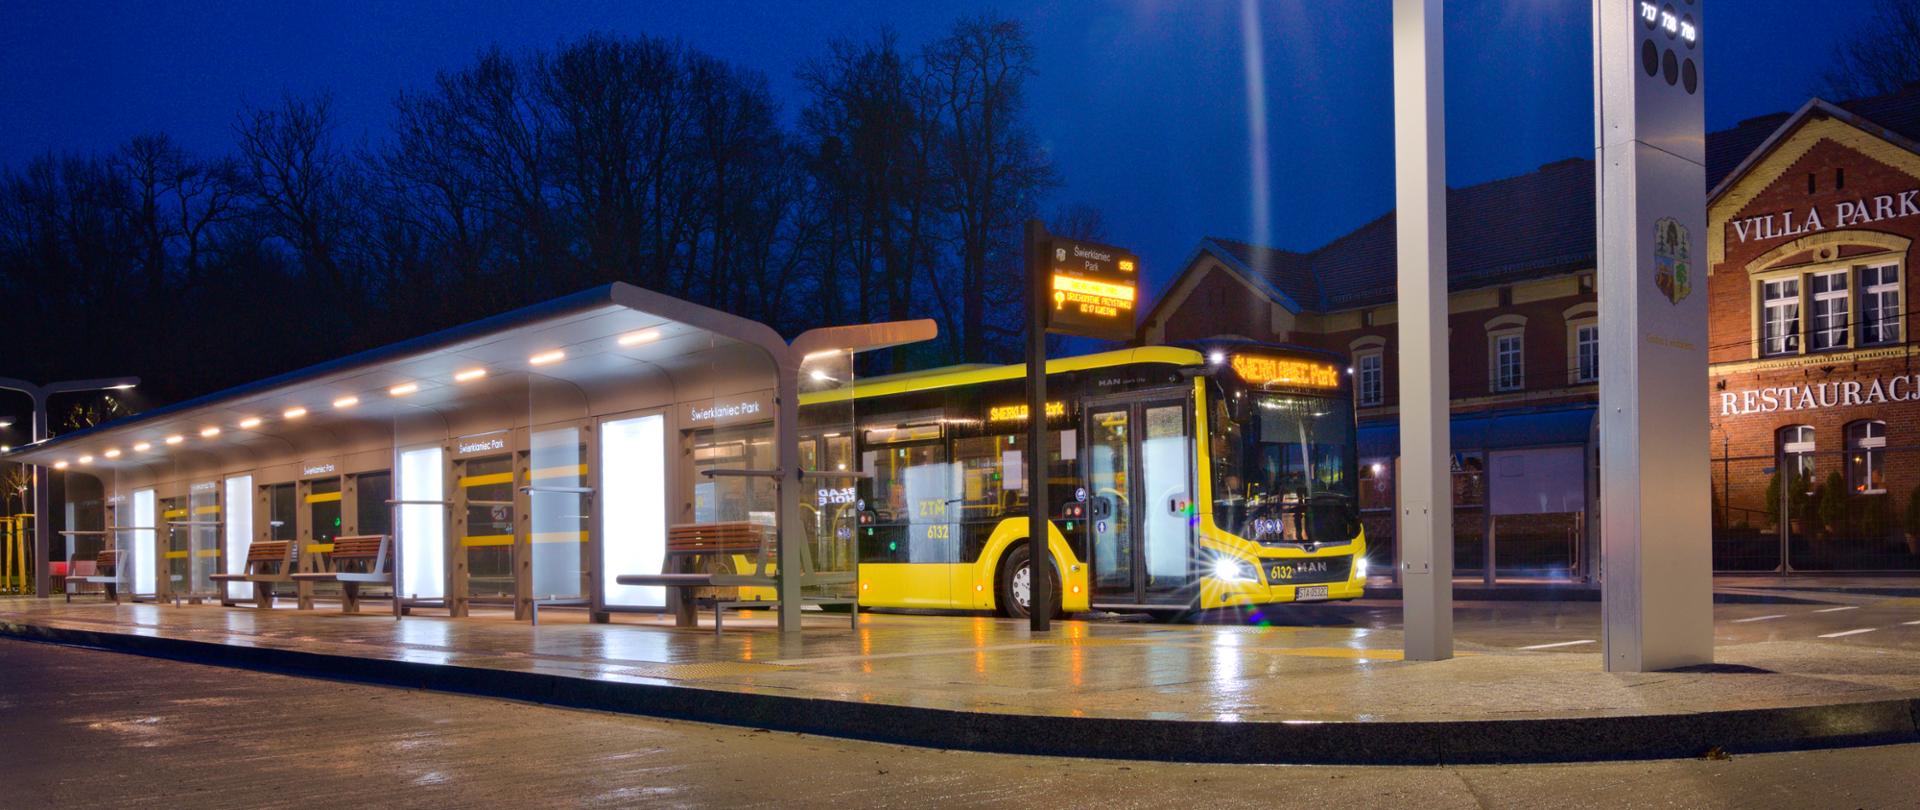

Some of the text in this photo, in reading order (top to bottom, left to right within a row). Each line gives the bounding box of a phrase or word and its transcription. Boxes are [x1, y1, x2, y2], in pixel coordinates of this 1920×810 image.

[1641, 2, 1657, 21] 717
[1733, 190, 1920, 243] VILLA PARK
[1085, 261, 1099, 271] Park
[1098, 378, 1122, 387] MAN
[1310, 363, 1338, 387] Park
[1720, 375, 1920, 416] RESTAURACJ
[691, 401, 760, 421] Świerklaniec Park
[491, 439, 504, 449] Park
[919, 499, 945, 517] ZTM
[927, 524, 949, 539] 6132
[1270, 565, 1293, 580] 6132
[1297, 561, 1328, 573] MAN
